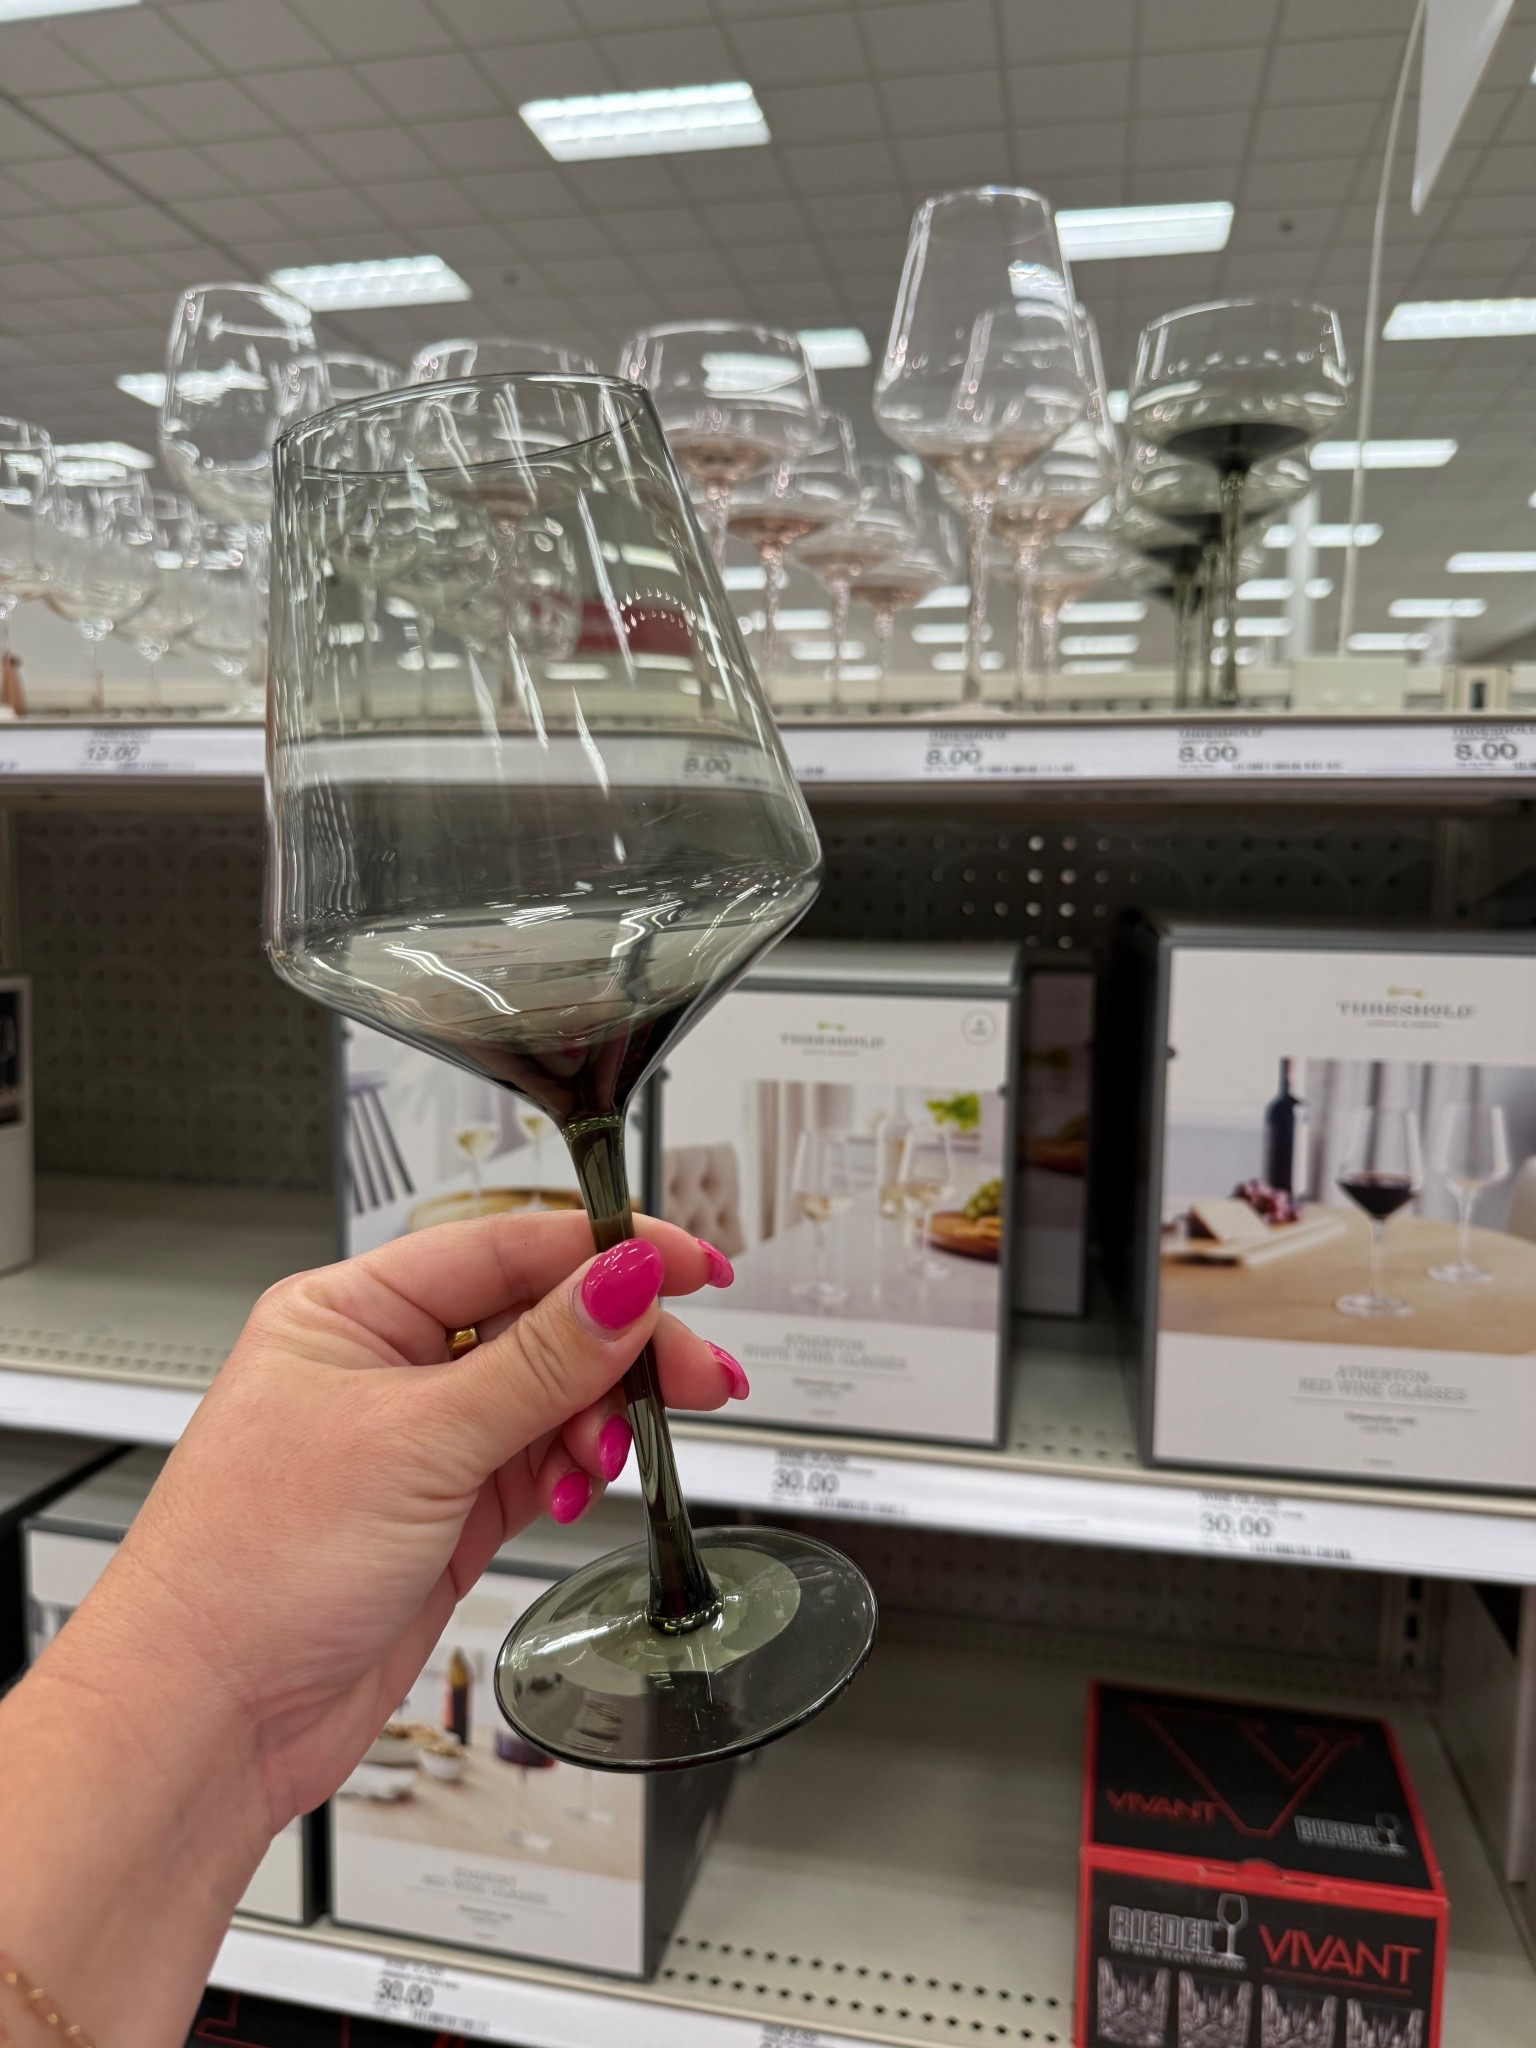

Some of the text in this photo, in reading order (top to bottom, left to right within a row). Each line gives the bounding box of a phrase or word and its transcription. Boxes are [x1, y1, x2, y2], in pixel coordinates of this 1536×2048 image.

[926, 749, 982, 766] 8.00
[1178, 746, 1239, 763] 8.00
[1455, 743, 1518, 760] 8.00
[1335, 1001, 1476, 1020] THRESHOLD
[1337, 1379, 1384, 1396] WINE
[1388, 1382, 1468, 1402] GLASSES
[1200, 1512, 1272, 1538] 30.00
[1105, 1788, 1218, 1826] VIVANT
[1109, 1904, 1216, 1955] RIEDEL
[1258, 1923, 1422, 1984] VIVANT
